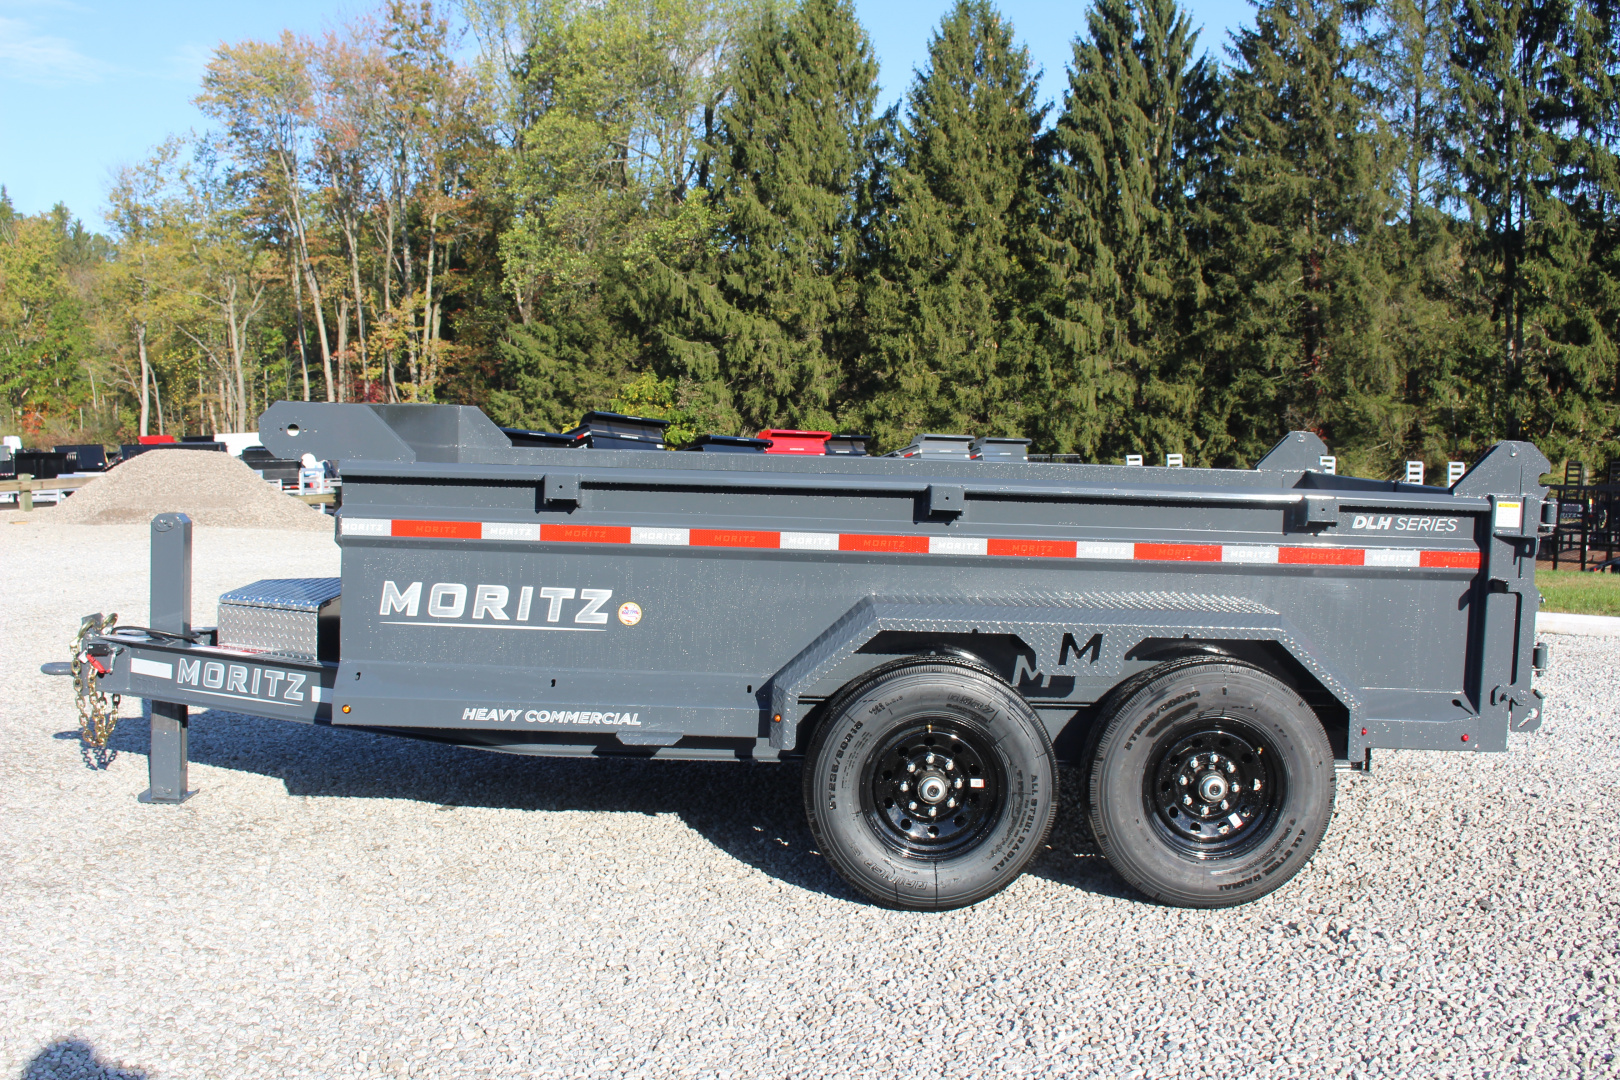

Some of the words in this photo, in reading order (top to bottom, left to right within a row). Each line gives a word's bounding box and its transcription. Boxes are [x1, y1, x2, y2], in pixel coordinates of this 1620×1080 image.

[1352, 516, 1392, 530] DLH
[1395, 517, 1458, 532] SERIES
[416, 525, 457, 534] MORITZ
[490, 527, 532, 537] MORITZ
[564, 528, 606, 538] MORITZ
[640, 532, 682, 542] MORITZ
[714, 534, 756, 544] MORITZ
[788, 536, 830, 546] MORITZ
[863, 538, 905, 548] MORITZ
[938, 542, 980, 550] MORITZ
[1012, 544, 1054, 554] MORITZ
[1085, 546, 1127, 556] MORITZ
[1158, 548, 1200, 557] MORITZ
[1230, 550, 1272, 559] MORITZ
[1302, 552, 1343, 561] MORITZ
[1372, 554, 1413, 562] MORITZ
[379, 581, 613, 625] MORITZ
[1058, 632, 1104, 666] M
[177, 658, 307, 702] MORITZ
[462, 708, 524, 722] HEAVY
[525, 710, 642, 726] COMMERCIAL
[1030, 773, 1039, 795] ALL
[1021, 798, 1038, 834] STEEL
[990, 834, 1026, 873] RADIAL
